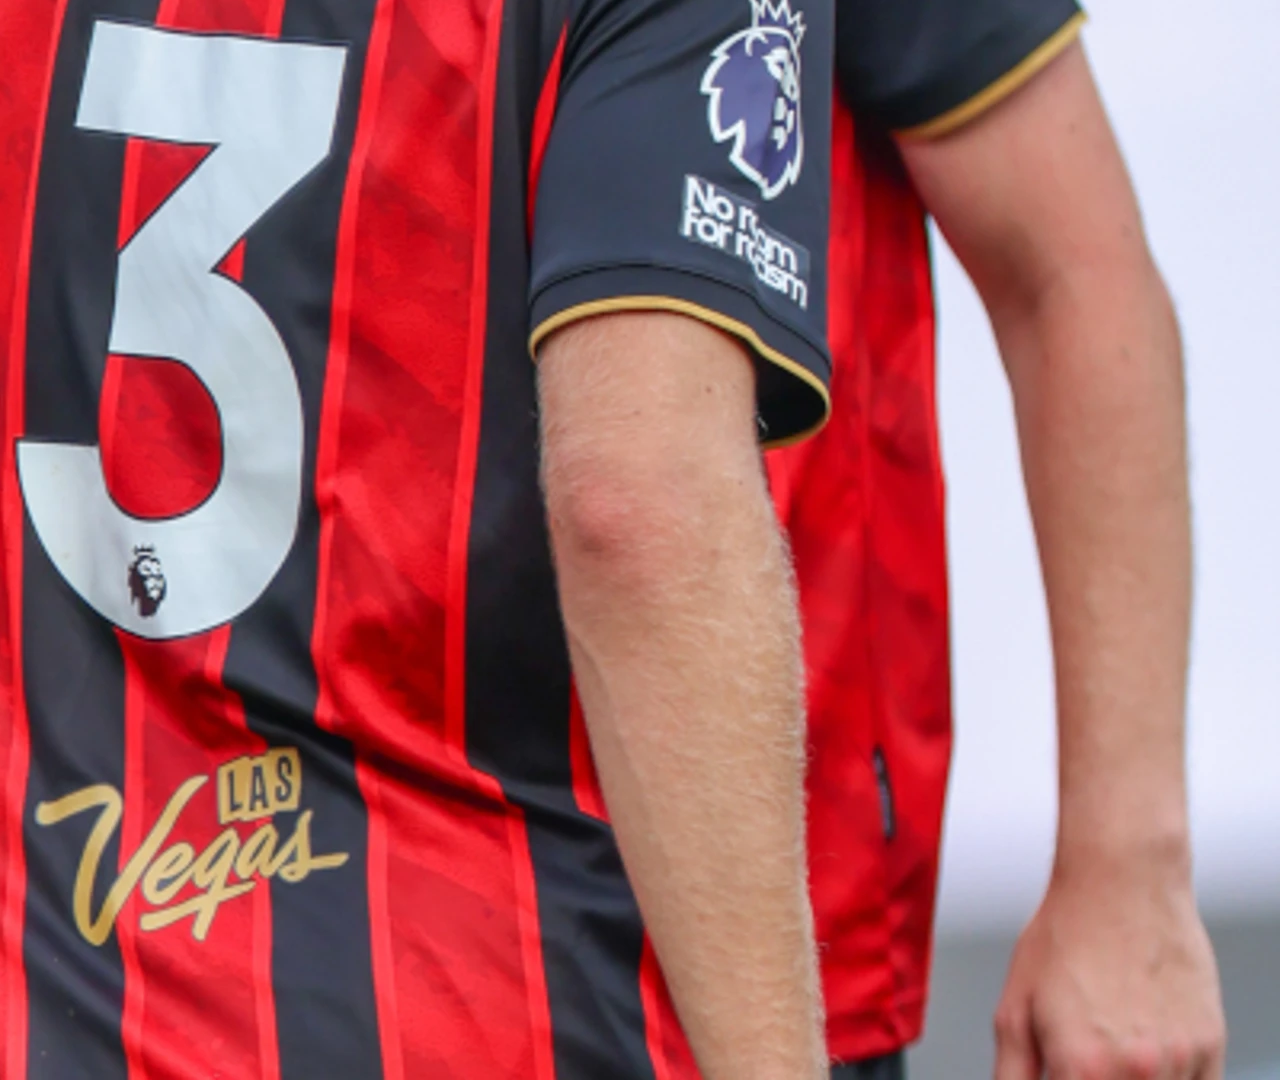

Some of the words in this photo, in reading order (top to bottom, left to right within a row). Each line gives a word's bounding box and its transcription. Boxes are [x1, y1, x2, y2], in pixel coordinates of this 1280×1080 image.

[682, 207, 733, 249] for
[685, 174, 735, 221] No
[15, 20, 351, 640] 3
[225, 752, 296, 815] LAS
[35, 775, 349, 946] Vegas
